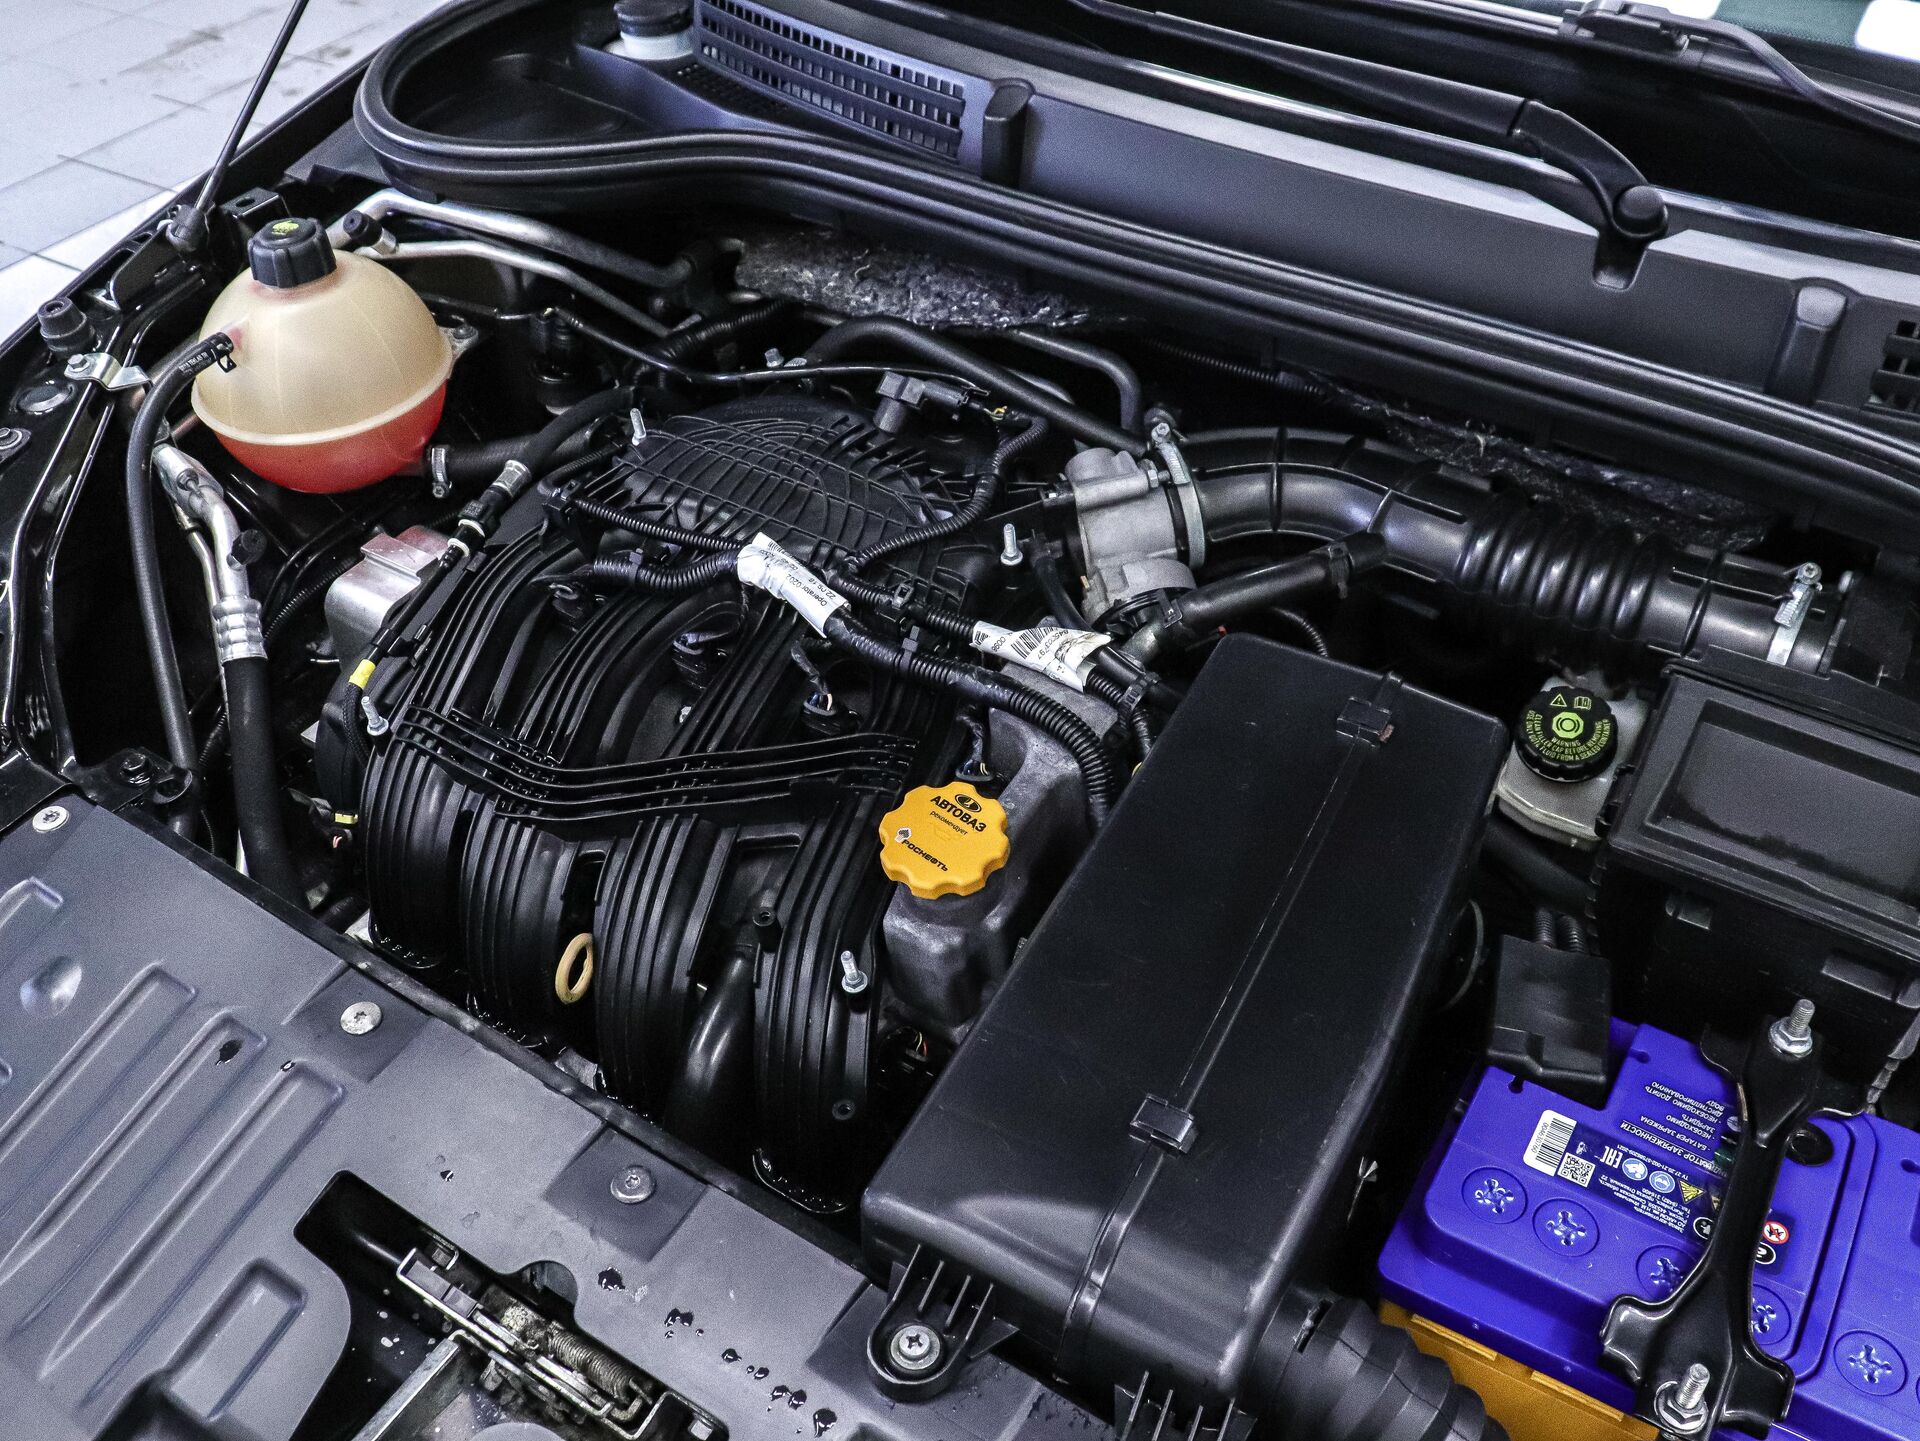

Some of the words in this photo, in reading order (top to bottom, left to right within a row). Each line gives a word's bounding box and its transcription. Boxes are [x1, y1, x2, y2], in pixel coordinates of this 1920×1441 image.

[800, 583, 828, 607] Operator
[1536, 730, 1552, 748] FILLER
[1552, 744, 1564, 753] CAP
[1564, 744, 1589, 754] BEFORE
[1539, 745, 1556, 758] FLUID
[1556, 753, 1574, 761] FROM
[1580, 745, 1601, 760] SEALED
[1552, 737, 1581, 747] WARNING
[930, 796, 986, 832] АВТОВАЗ
[930, 811, 968, 835] рекомендует
[902, 839, 948, 872] РОСНЕФТЬ
[1643, 1084, 1671, 1101] ДОЛИТЬ
[1650, 1080, 1723, 1118] ДИСТИЛЛИРОВАННУЮ
[1705, 1098, 1725, 1111] ВОДУ
[1671, 1097, 1718, 1123] НЕОБХОДИМО
[1639, 1114, 1677, 1136] ЗАРЯЖЕНА
[1664, 1113, 1711, 1139] НЕОБХОДИМО
[1680, 1112, 1716, 1133] ЗАРЯДИТЬ
[1619, 1120, 1684, 1156] ЗАРЯЖЕННОСТИ
[1675, 1132, 1707, 1151] БАТАРЕЯ
